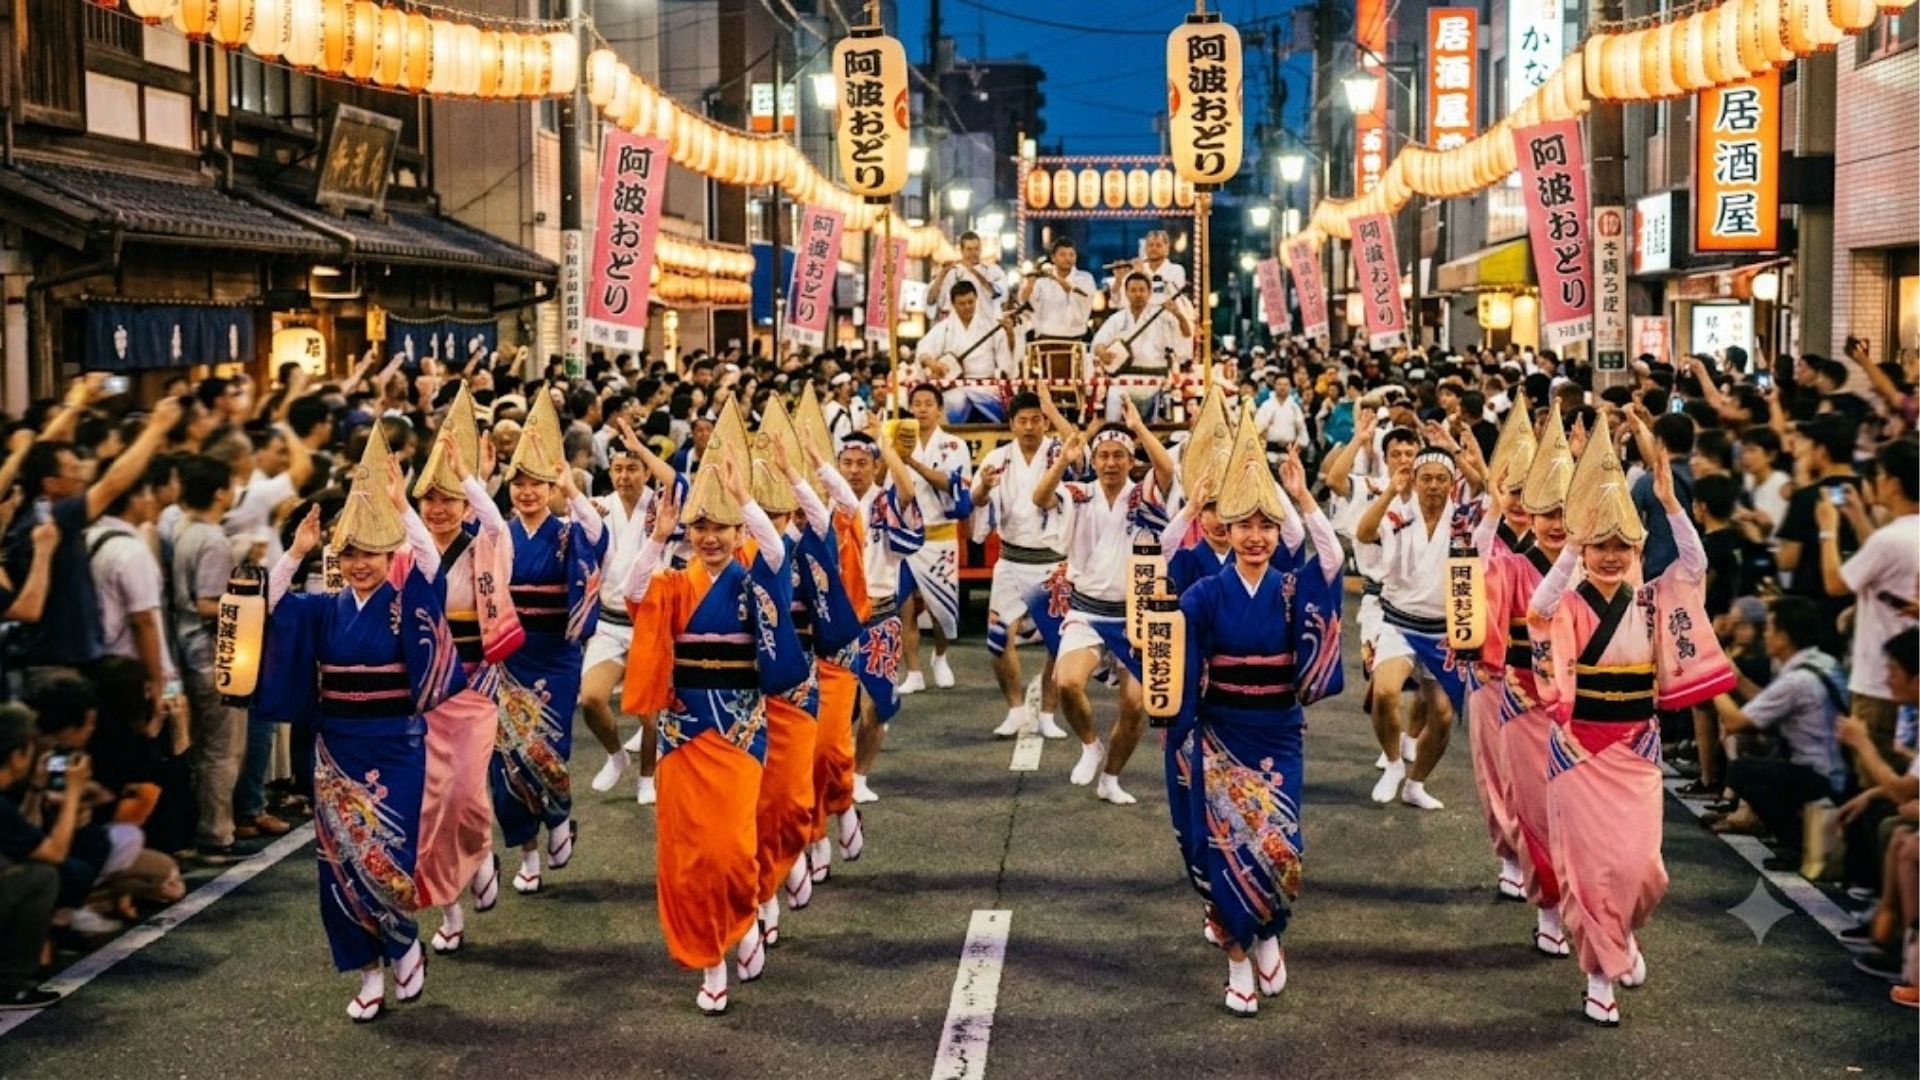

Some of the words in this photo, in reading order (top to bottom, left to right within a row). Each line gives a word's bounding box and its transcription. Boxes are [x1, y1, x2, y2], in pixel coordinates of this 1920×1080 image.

[844, 49, 890, 189] 阿波おどり
[1187, 33, 1231, 175] 阿波おどり
[1716, 89, 1760, 234] 居酒屋
[604, 145, 653, 314] 阿波おどり
[1530, 133, 1587, 308] 阿波おどり
